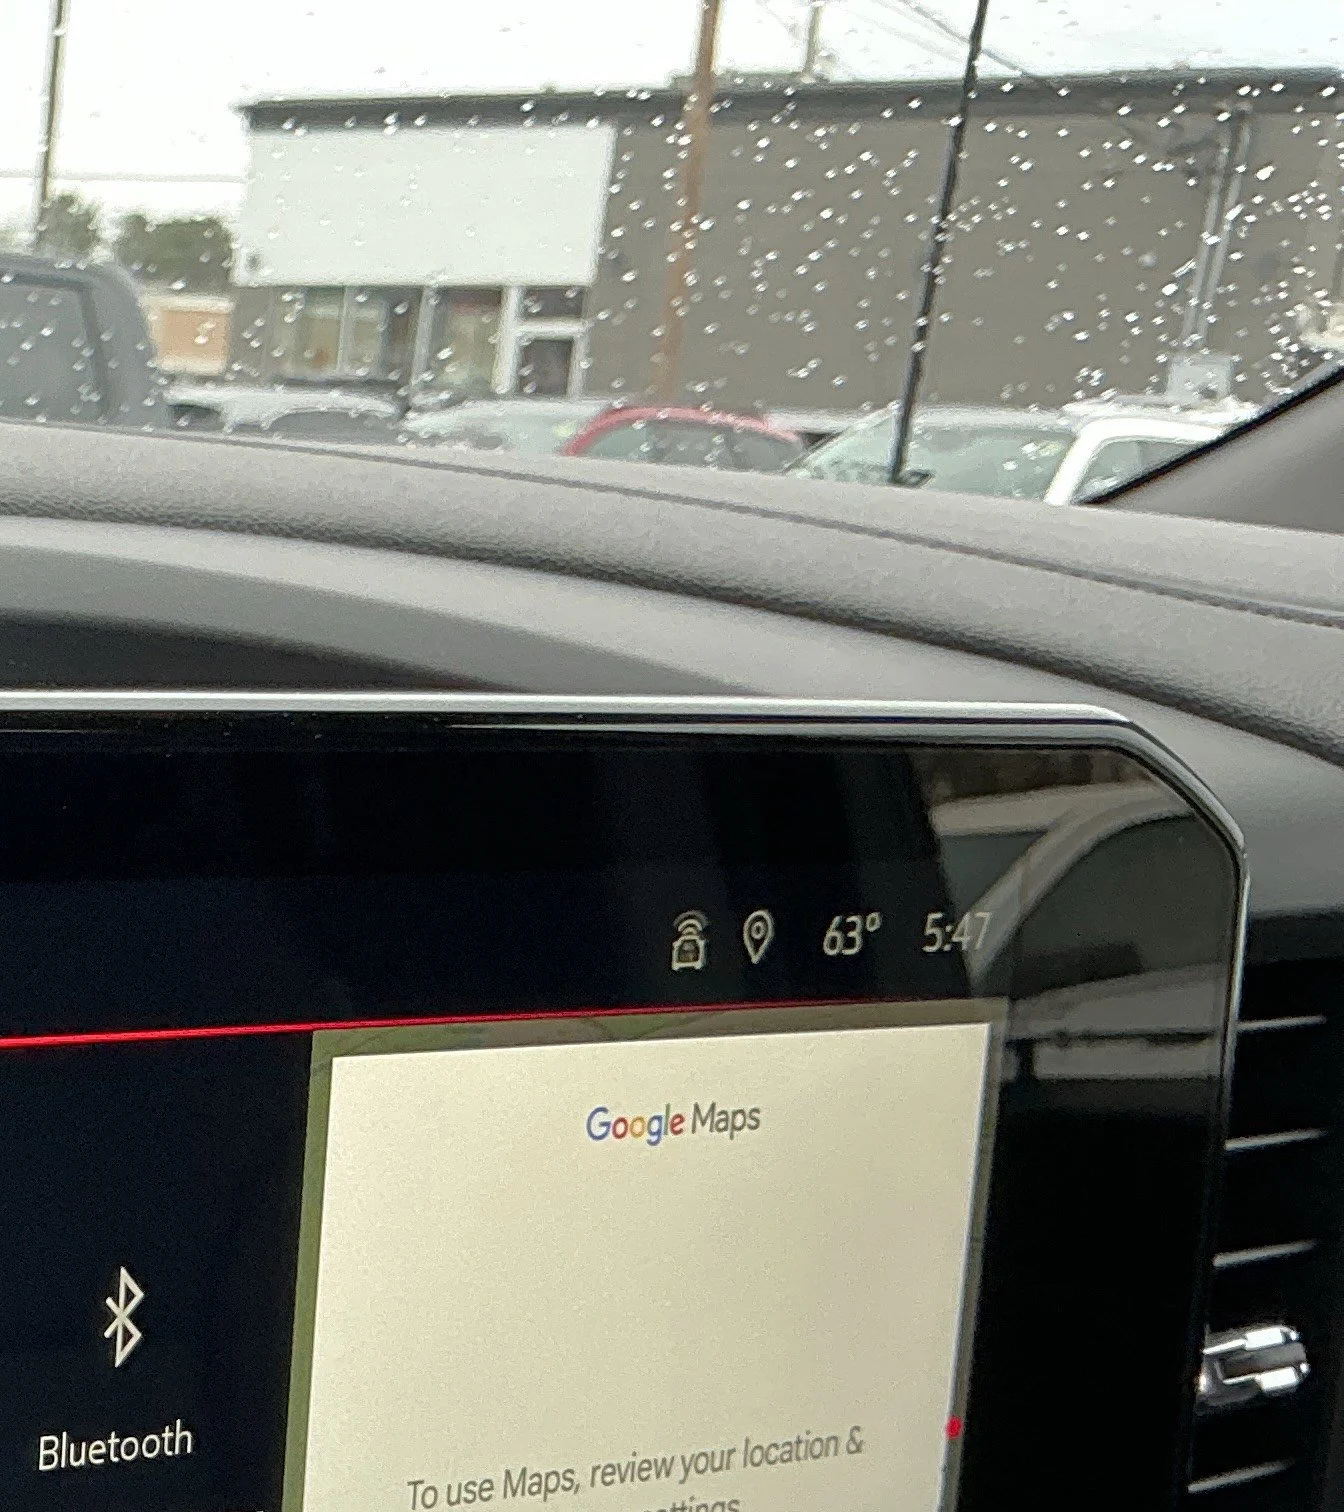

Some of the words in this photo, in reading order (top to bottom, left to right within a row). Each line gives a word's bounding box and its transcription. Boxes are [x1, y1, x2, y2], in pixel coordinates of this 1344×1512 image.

[822, 911, 882, 956] 63°
[922, 911, 993, 953] 5:47
[586, 1102, 685, 1146] Google
[691, 1101, 761, 1141] Maps
[37, 1418, 193, 1471] Bluetooth
[407, 1478, 439, 1511] To
[445, 1475, 495, 1507] use
[502, 1464, 581, 1502] Maps,
[589, 1450, 674, 1488] review
[678, 1445, 737, 1484] your
[742, 1429, 839, 1469] location
[845, 1425, 865, 1454] &
